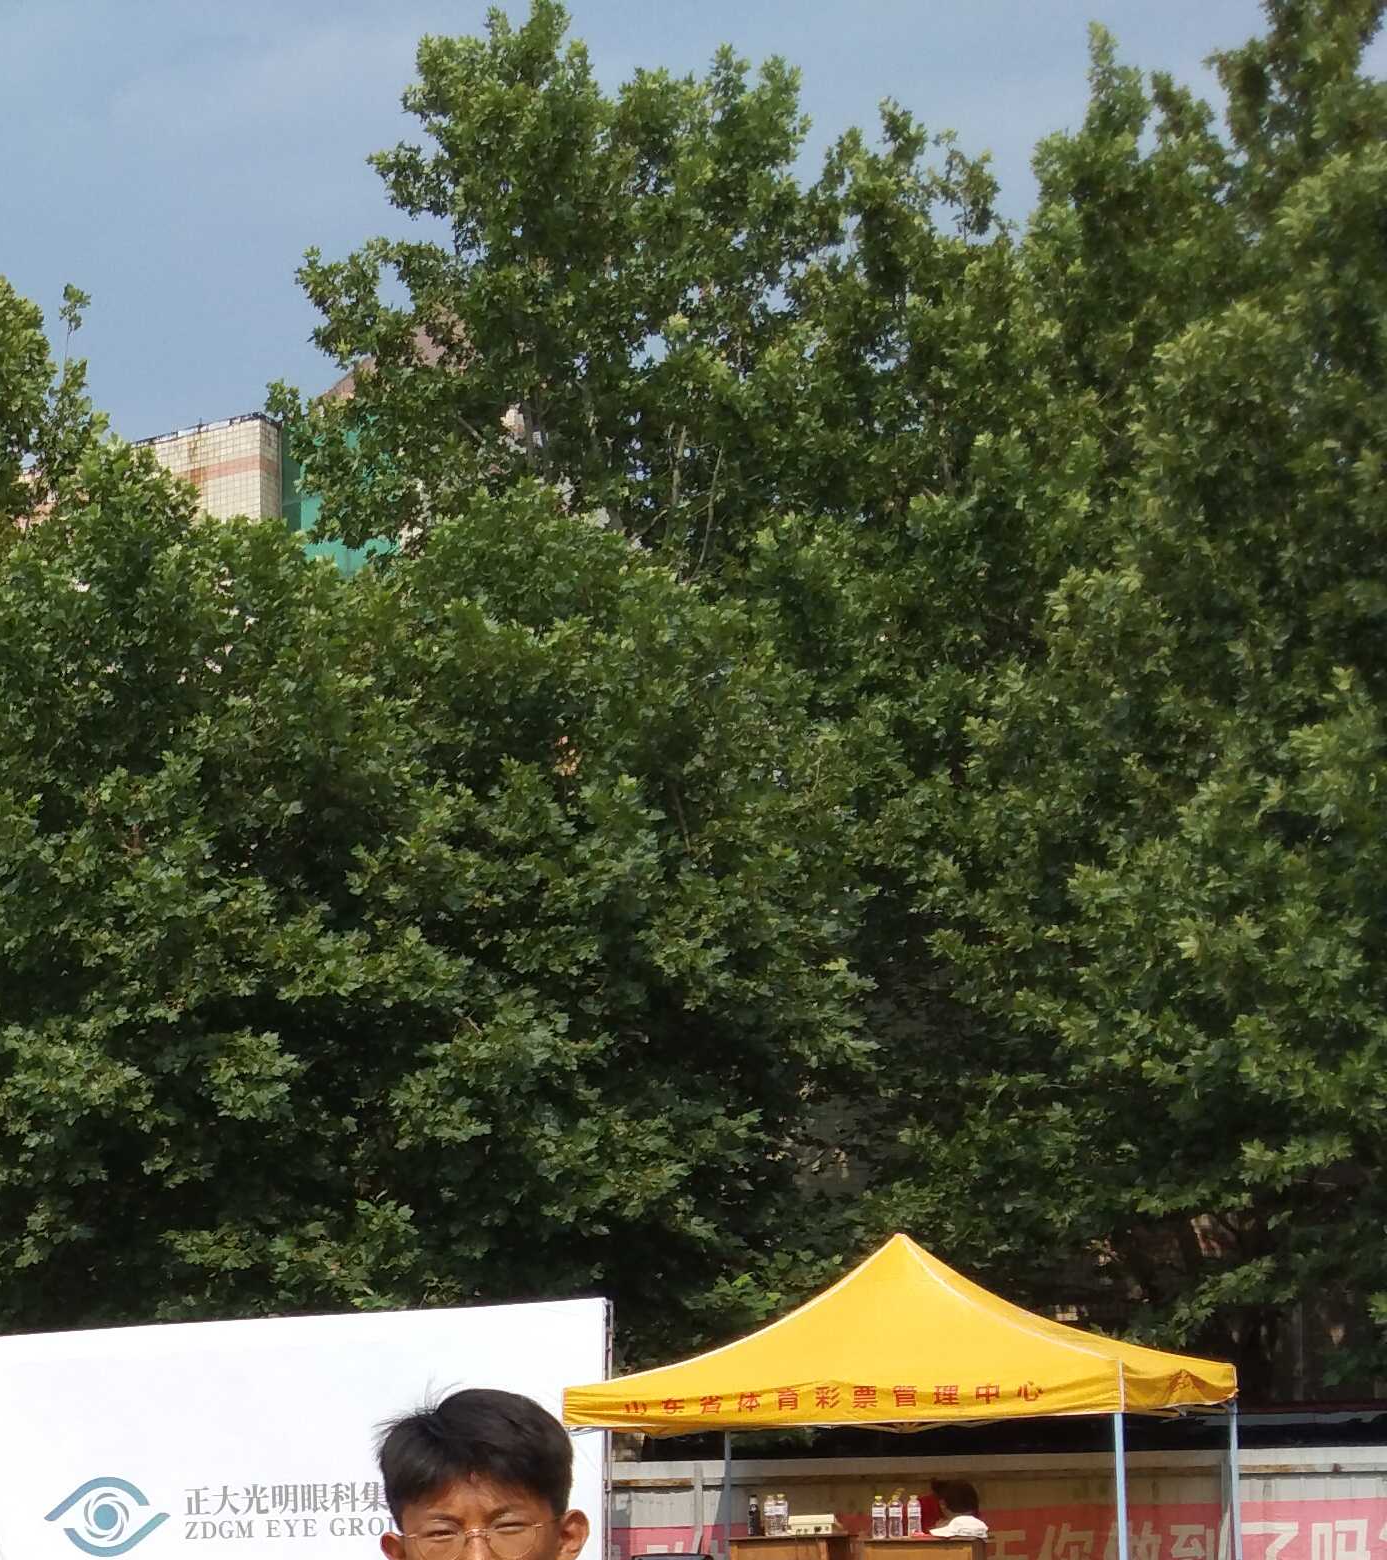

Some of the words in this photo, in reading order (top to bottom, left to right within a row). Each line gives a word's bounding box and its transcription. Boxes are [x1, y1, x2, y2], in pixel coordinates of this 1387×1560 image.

[624, 1380, 1043, 1416] 山东省体育彩票管理中心
[184, 1481, 390, 1516] 正大光明眼科集
[184, 1519, 255, 1540] ZDGM
[266, 1518, 318, 1538] EYE
[329, 1516, 397, 1537] GRO
